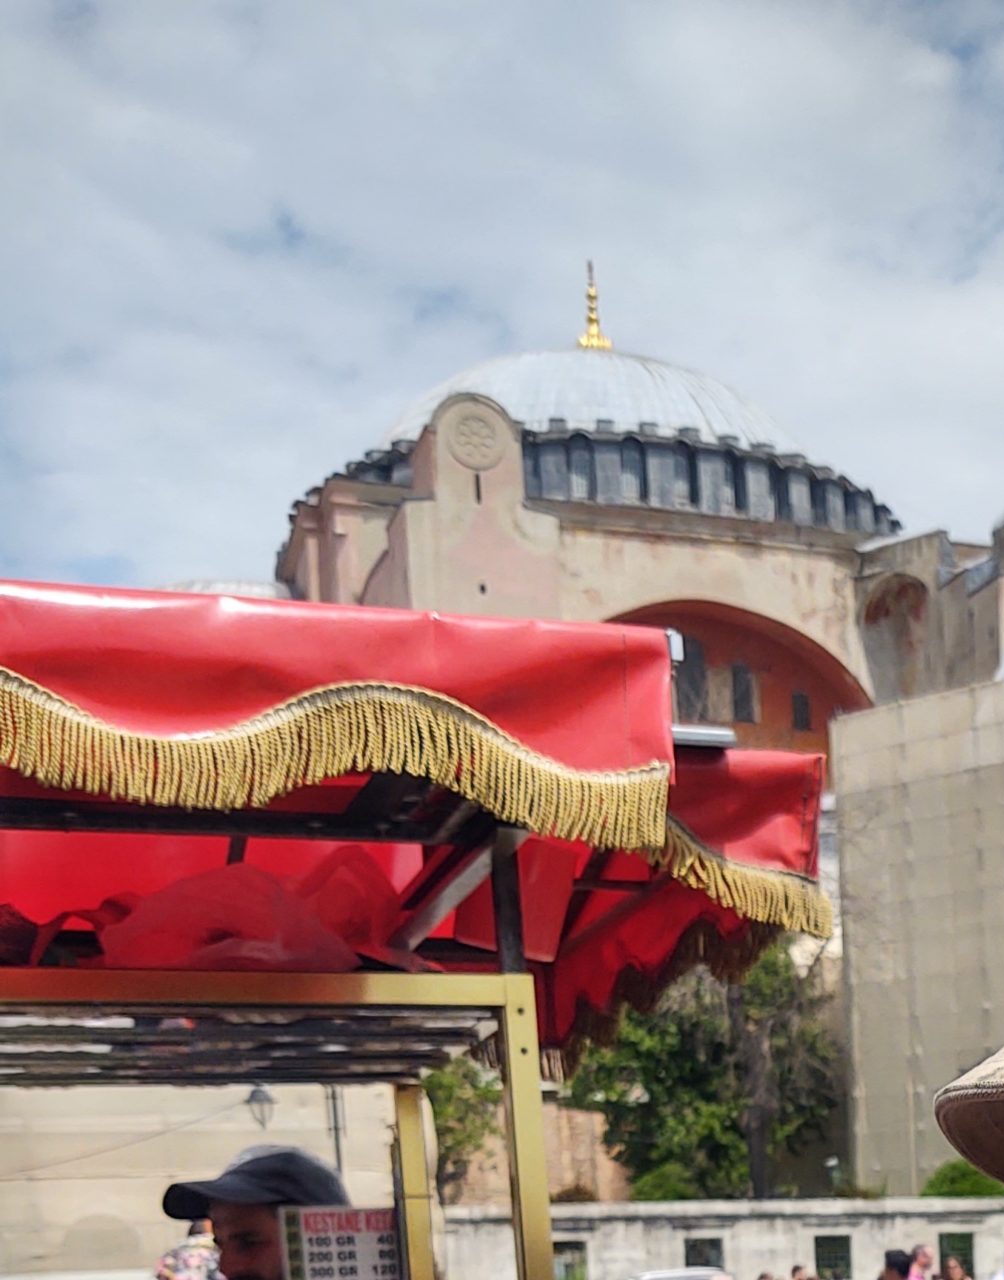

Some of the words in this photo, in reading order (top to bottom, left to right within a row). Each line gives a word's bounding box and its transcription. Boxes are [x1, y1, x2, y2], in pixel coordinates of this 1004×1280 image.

[307, 1236, 332, 1247] 100
[335, 1236, 356, 1246] GR
[376, 1234, 394, 1245] 40
[308, 1251, 333, 1263] 200
[337, 1251, 357, 1262] GR
[309, 1267, 335, 1277] 300
[338, 1266, 358, 1276] GR
[372, 1265, 397, 1275] 120
